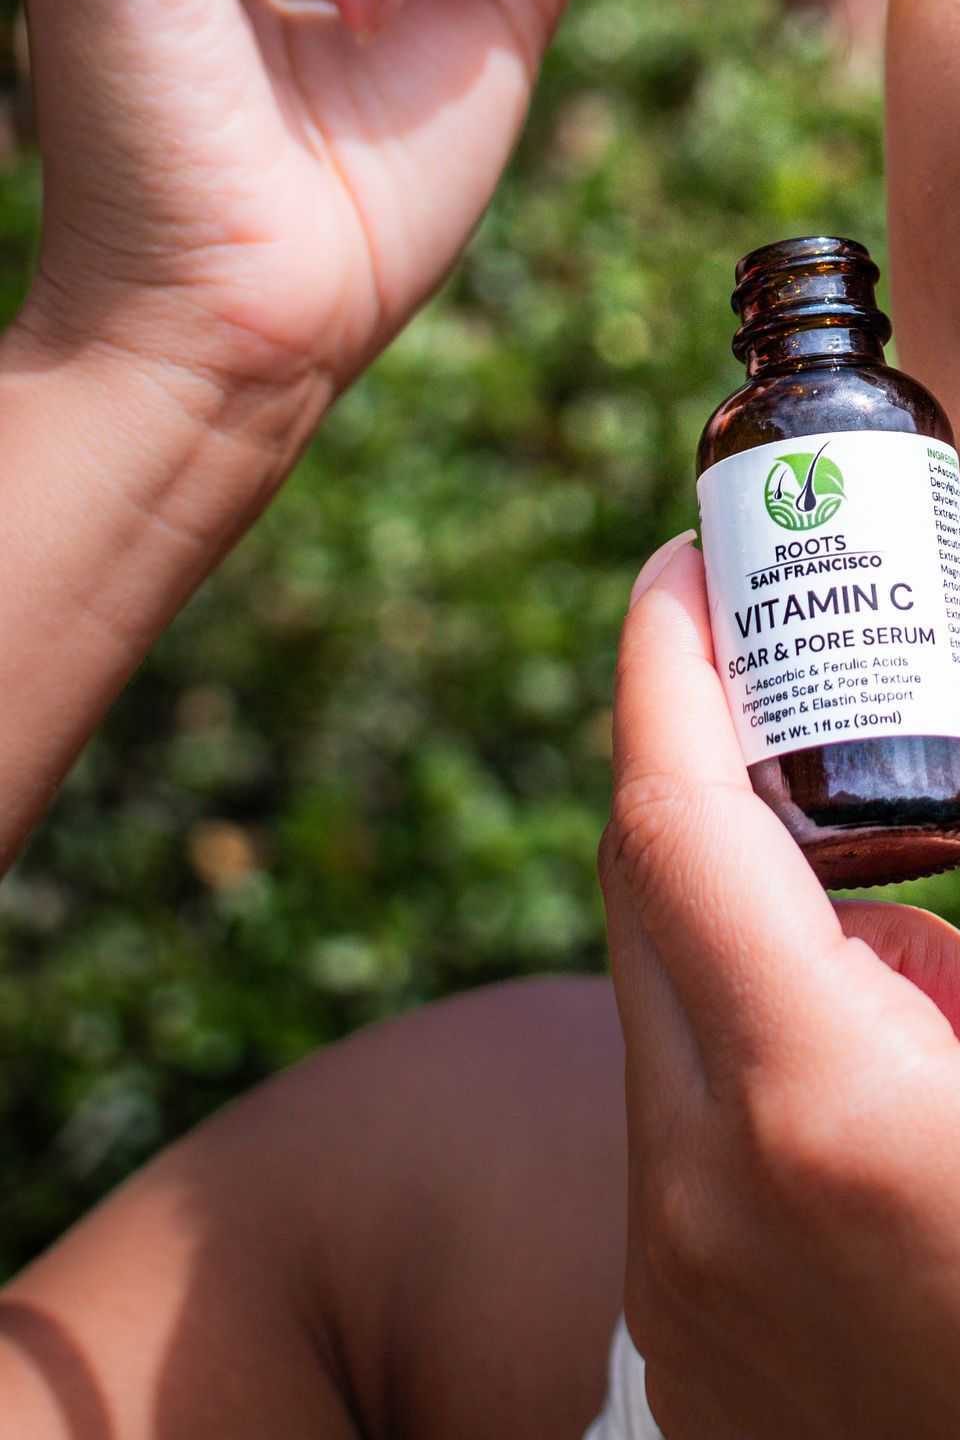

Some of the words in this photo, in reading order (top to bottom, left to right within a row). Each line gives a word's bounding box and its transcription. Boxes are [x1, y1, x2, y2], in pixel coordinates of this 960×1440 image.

[935, 520, 958, 535] Flower
[775, 534, 847, 562] ROOTS
[750, 570, 780, 590] SAN
[784, 555, 882, 581] FRANCISCO
[735, 583, 878, 638] VITAMIN
[890, 583, 914, 610] C
[729, 648, 768, 679] SCAR
[775, 643, 789, 661] &
[795, 629, 855, 656] PORE
[862, 627, 936, 646] SERUM
[742, 691, 788, 714] Improves
[792, 683, 819, 699] Scar
[824, 679, 833, 691] &
[838, 676, 868, 689] Pore
[873, 673, 921, 685] Texture
[746, 667, 805, 695] L-Ascorbic
[809, 665, 818, 677] &
[824, 658, 867, 673] Ferulic
[873, 656, 908, 668] Acids
[751, 707, 796, 728] Collagen
[799, 702, 808, 714] &
[813, 694, 856, 710] Elastin
[860, 690, 913, 705] Support
[766, 731, 786, 746] Net
[788, 724, 810, 740] Wt.
[814, 721, 819, 734] 1
[822, 718, 831, 732] fl
[835, 718, 850, 729] oz
[854, 711, 902, 727] (30ml)
